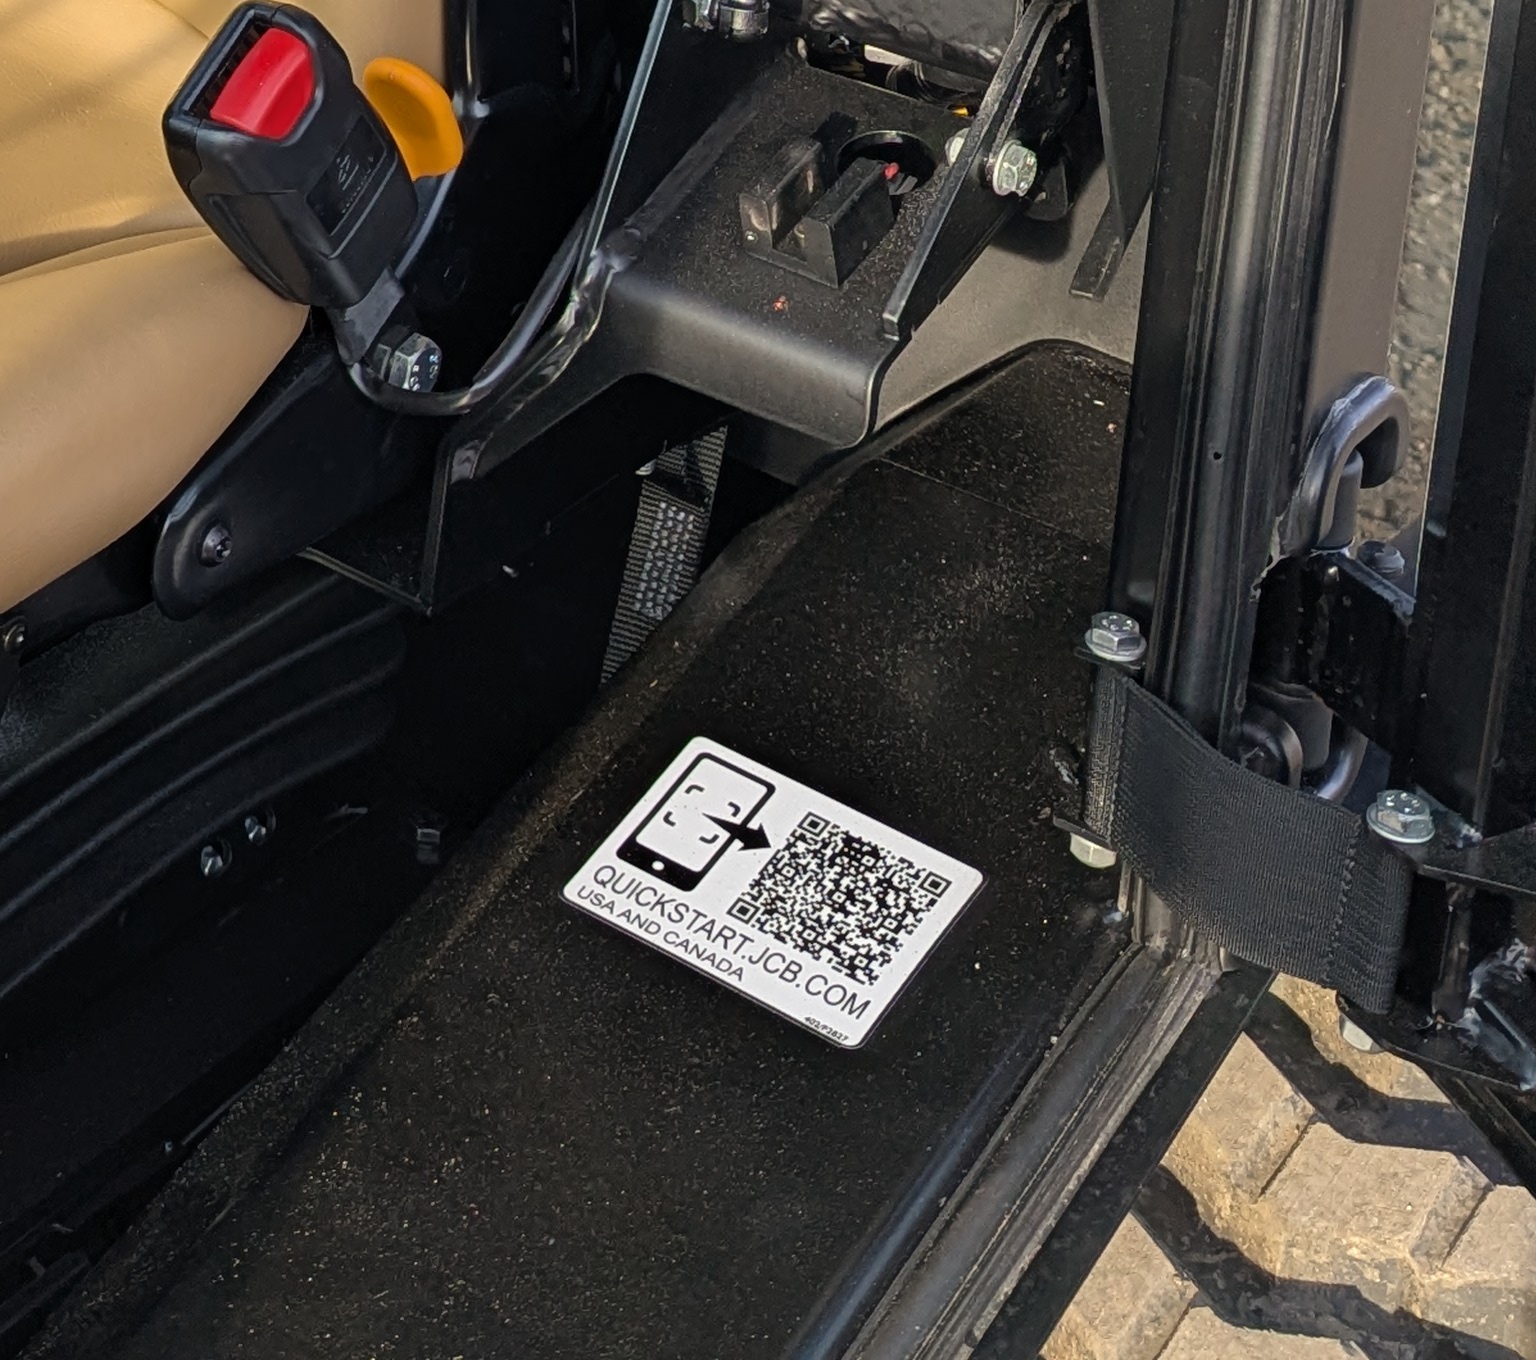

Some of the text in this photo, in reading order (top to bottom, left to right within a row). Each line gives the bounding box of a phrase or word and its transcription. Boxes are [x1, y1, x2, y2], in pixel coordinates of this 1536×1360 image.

[577, 885, 745, 983] USA AND CANADA
[592, 864, 872, 1021] QUICKSTART.JCB.COM
